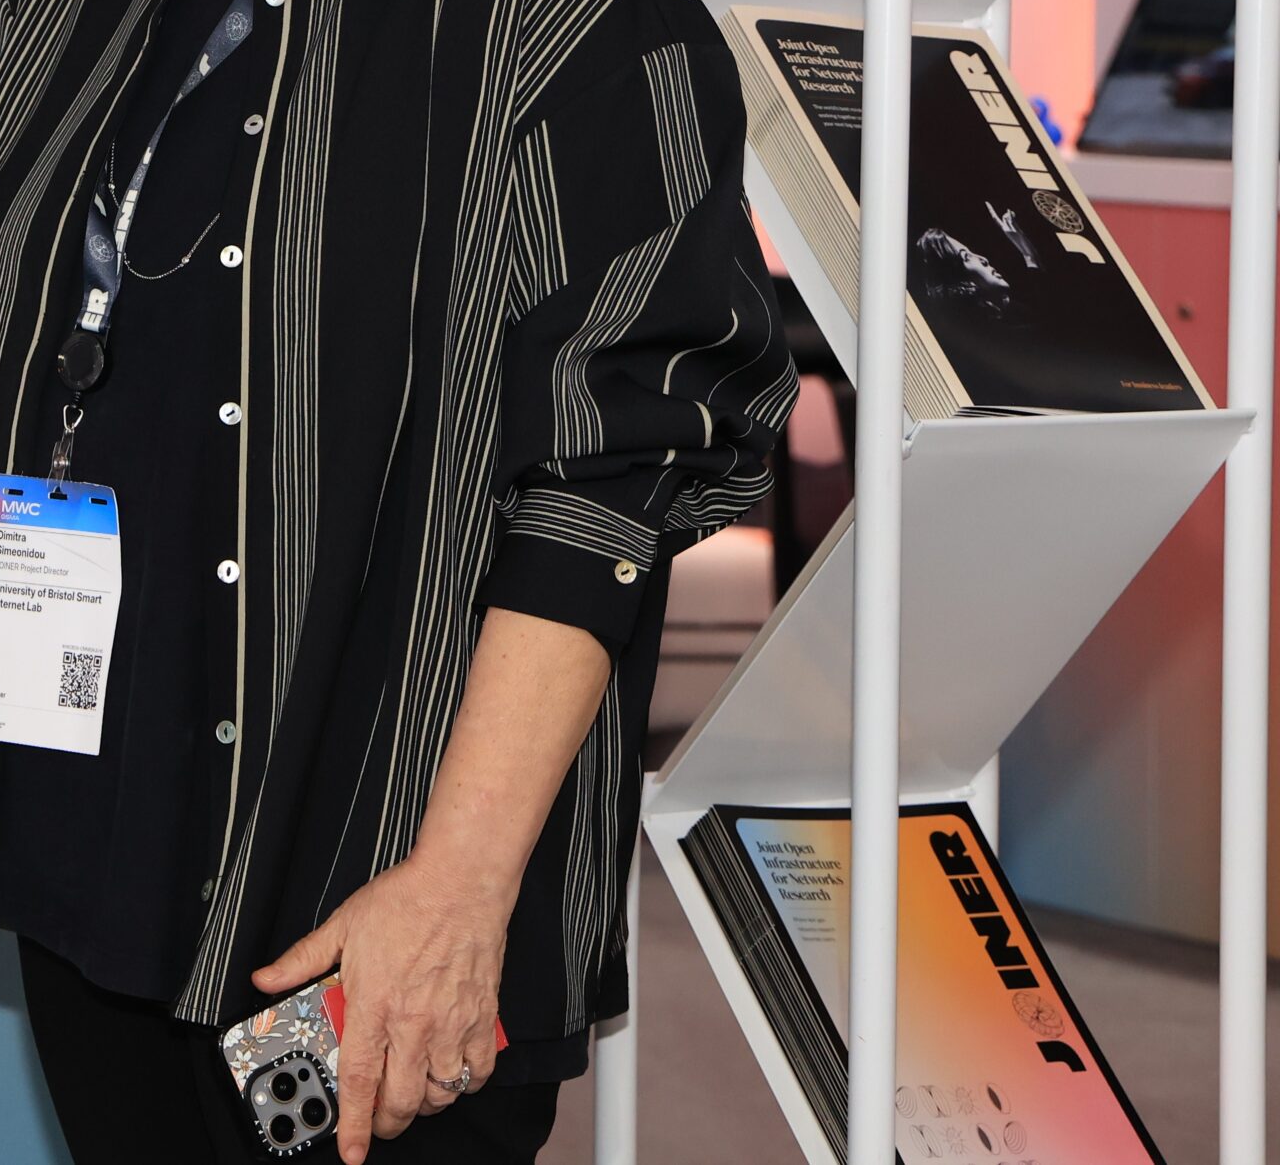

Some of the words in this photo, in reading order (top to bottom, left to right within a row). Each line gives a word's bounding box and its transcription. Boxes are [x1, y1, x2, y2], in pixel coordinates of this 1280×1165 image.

[776, 38, 807, 51] Joint
[806, 41, 840, 55] Open
[791, 65, 811, 77] for
[799, 79, 856, 95] Research
[949, 50, 1106, 264] JOINER
[1, 500, 41, 516] MWC
[21, 563, 42, 574] Project
[43, 565, 69, 576] Director
[37, 588, 47, 598] of
[48, 589, 75, 601] Bristol
[76, 592, 102, 604] Smart
[26, 601, 42, 613] Lab
[756, 841, 783, 853] Joint
[783, 842, 815, 856] Open
[762, 856, 842, 870] Infrastructure
[771, 872, 788, 884] for
[788, 873, 844, 886] Networks
[778, 888, 831, 901] Research
[930, 831, 1087, 1072] JOINER
